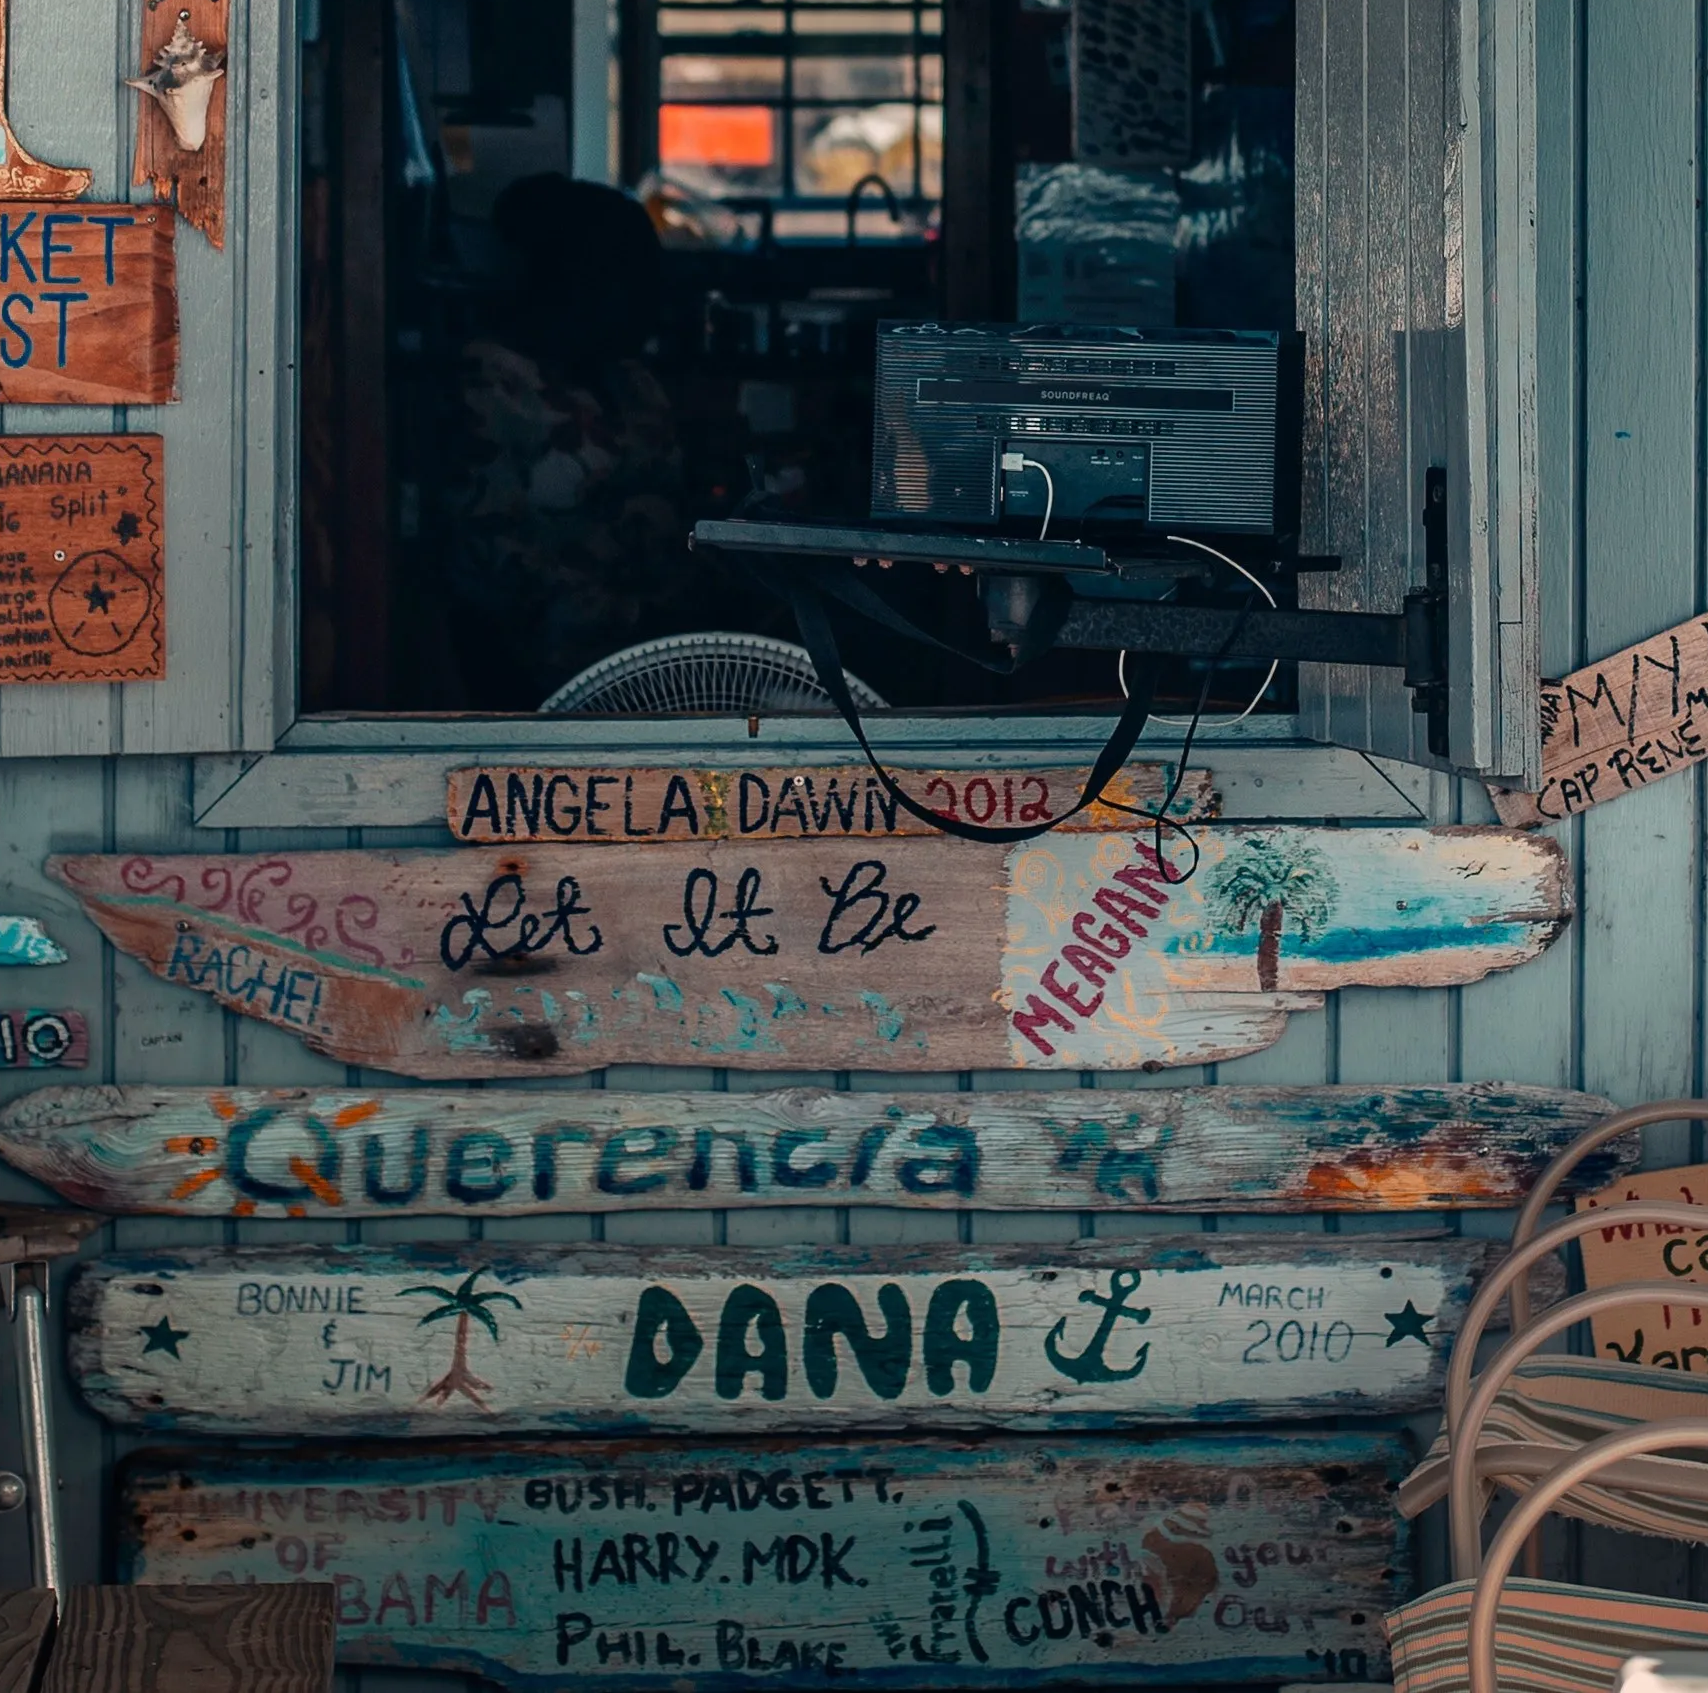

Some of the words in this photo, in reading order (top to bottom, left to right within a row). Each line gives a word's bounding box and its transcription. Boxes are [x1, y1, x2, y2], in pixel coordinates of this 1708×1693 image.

[1040, 389, 1111, 402] SOUNDFREAQ
[460, 772, 699, 839] ANGELA
[736, 772, 903, 836] DAWN
[925, 774, 1052, 826] 2012
[438, 871, 605, 973] Let
[662, 865, 779, 958] It
[816, 858, 937, 958] Be
[1011, 835, 1184, 1058] MEAGAN
[224, 1106, 980, 1208] Querencia
[236, 1280, 366, 1317] BONNIE
[1217, 1279, 1328, 1311] MARCH
[623, 1277, 1001, 1402] DANA
[1242, 1316, 1355, 1364] 2010
[320, 1357, 393, 1394] JIM
[274, 1532, 349, 1574] OF
